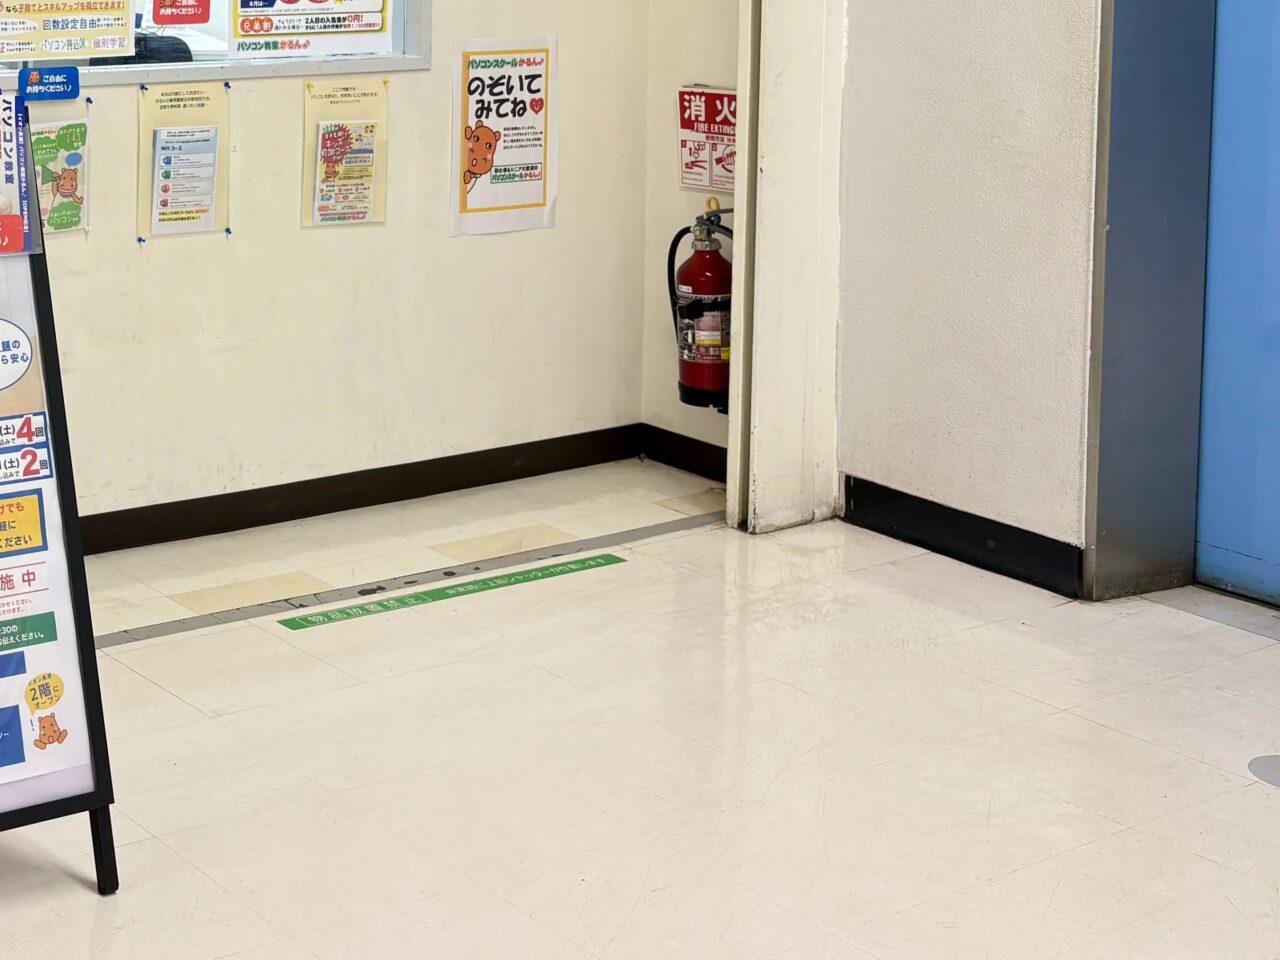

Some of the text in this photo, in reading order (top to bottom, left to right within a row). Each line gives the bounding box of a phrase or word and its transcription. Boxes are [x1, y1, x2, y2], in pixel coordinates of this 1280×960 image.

[43, 75, 67, 83] ご自由に
[467, 73, 542, 96] のぞいて
[475, 96, 527, 119] みてね
[683, 94, 736, 123] 消火
[694, 122, 708, 132] FIRE
[2, 98, 15, 185] パソコン教室
[34, 695, 61, 710] オープン
